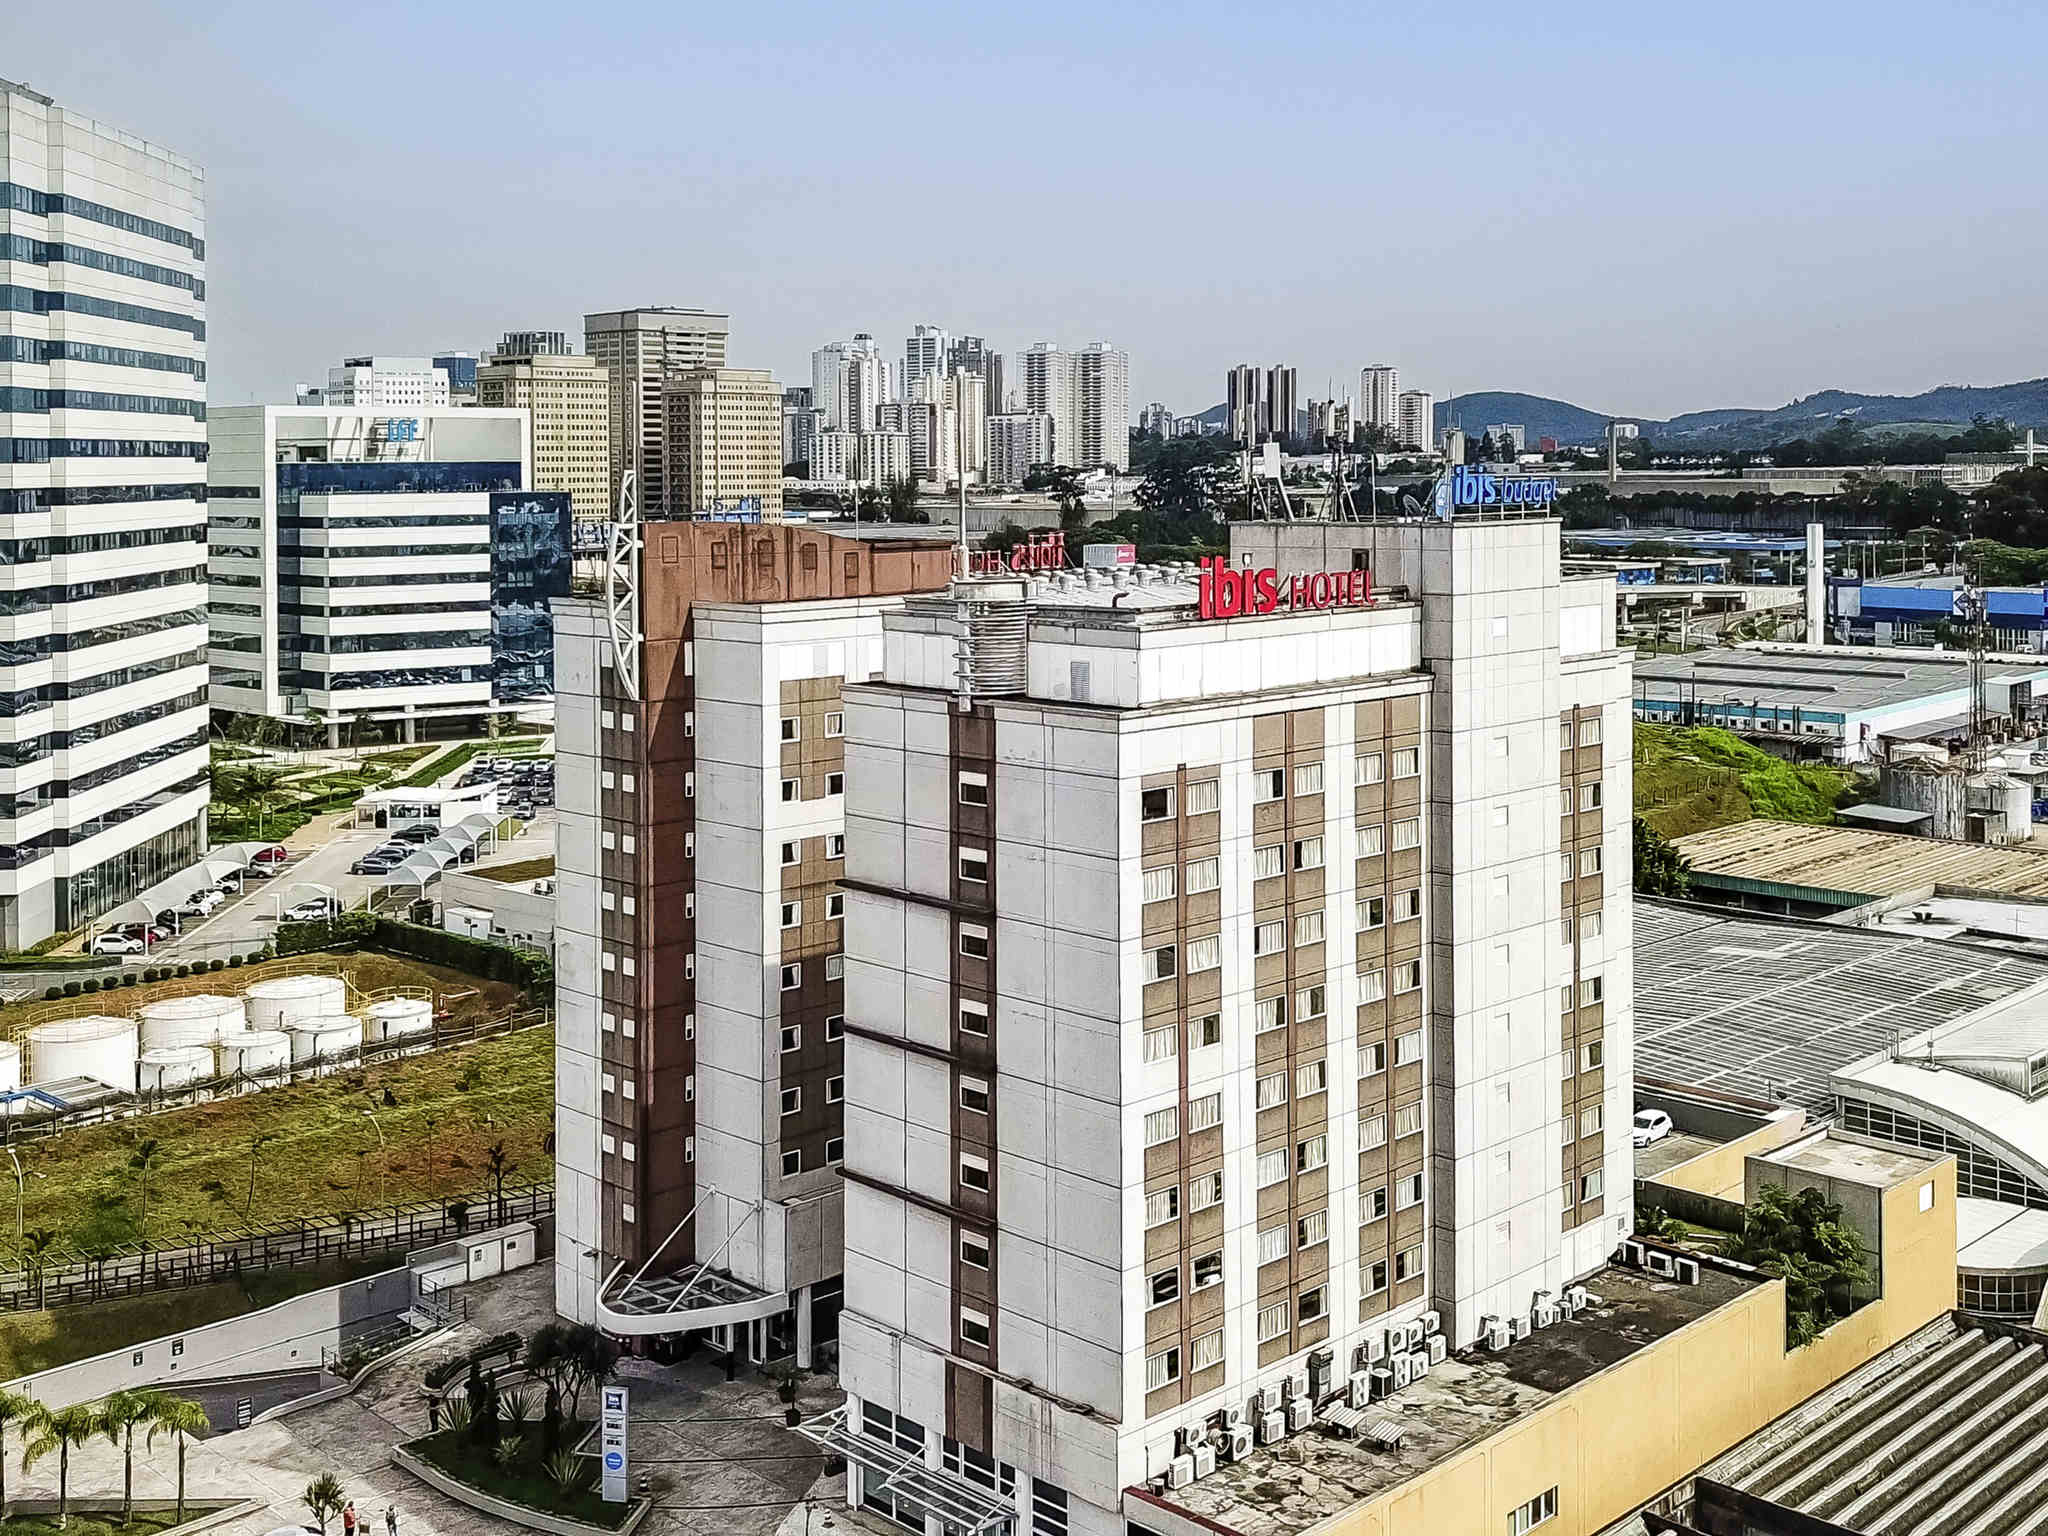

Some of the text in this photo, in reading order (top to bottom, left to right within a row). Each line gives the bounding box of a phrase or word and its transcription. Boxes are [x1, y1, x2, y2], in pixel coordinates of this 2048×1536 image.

[1452, 464, 1559, 508] ibis budget
[1199, 555, 1375, 620] ibis HOTEL
